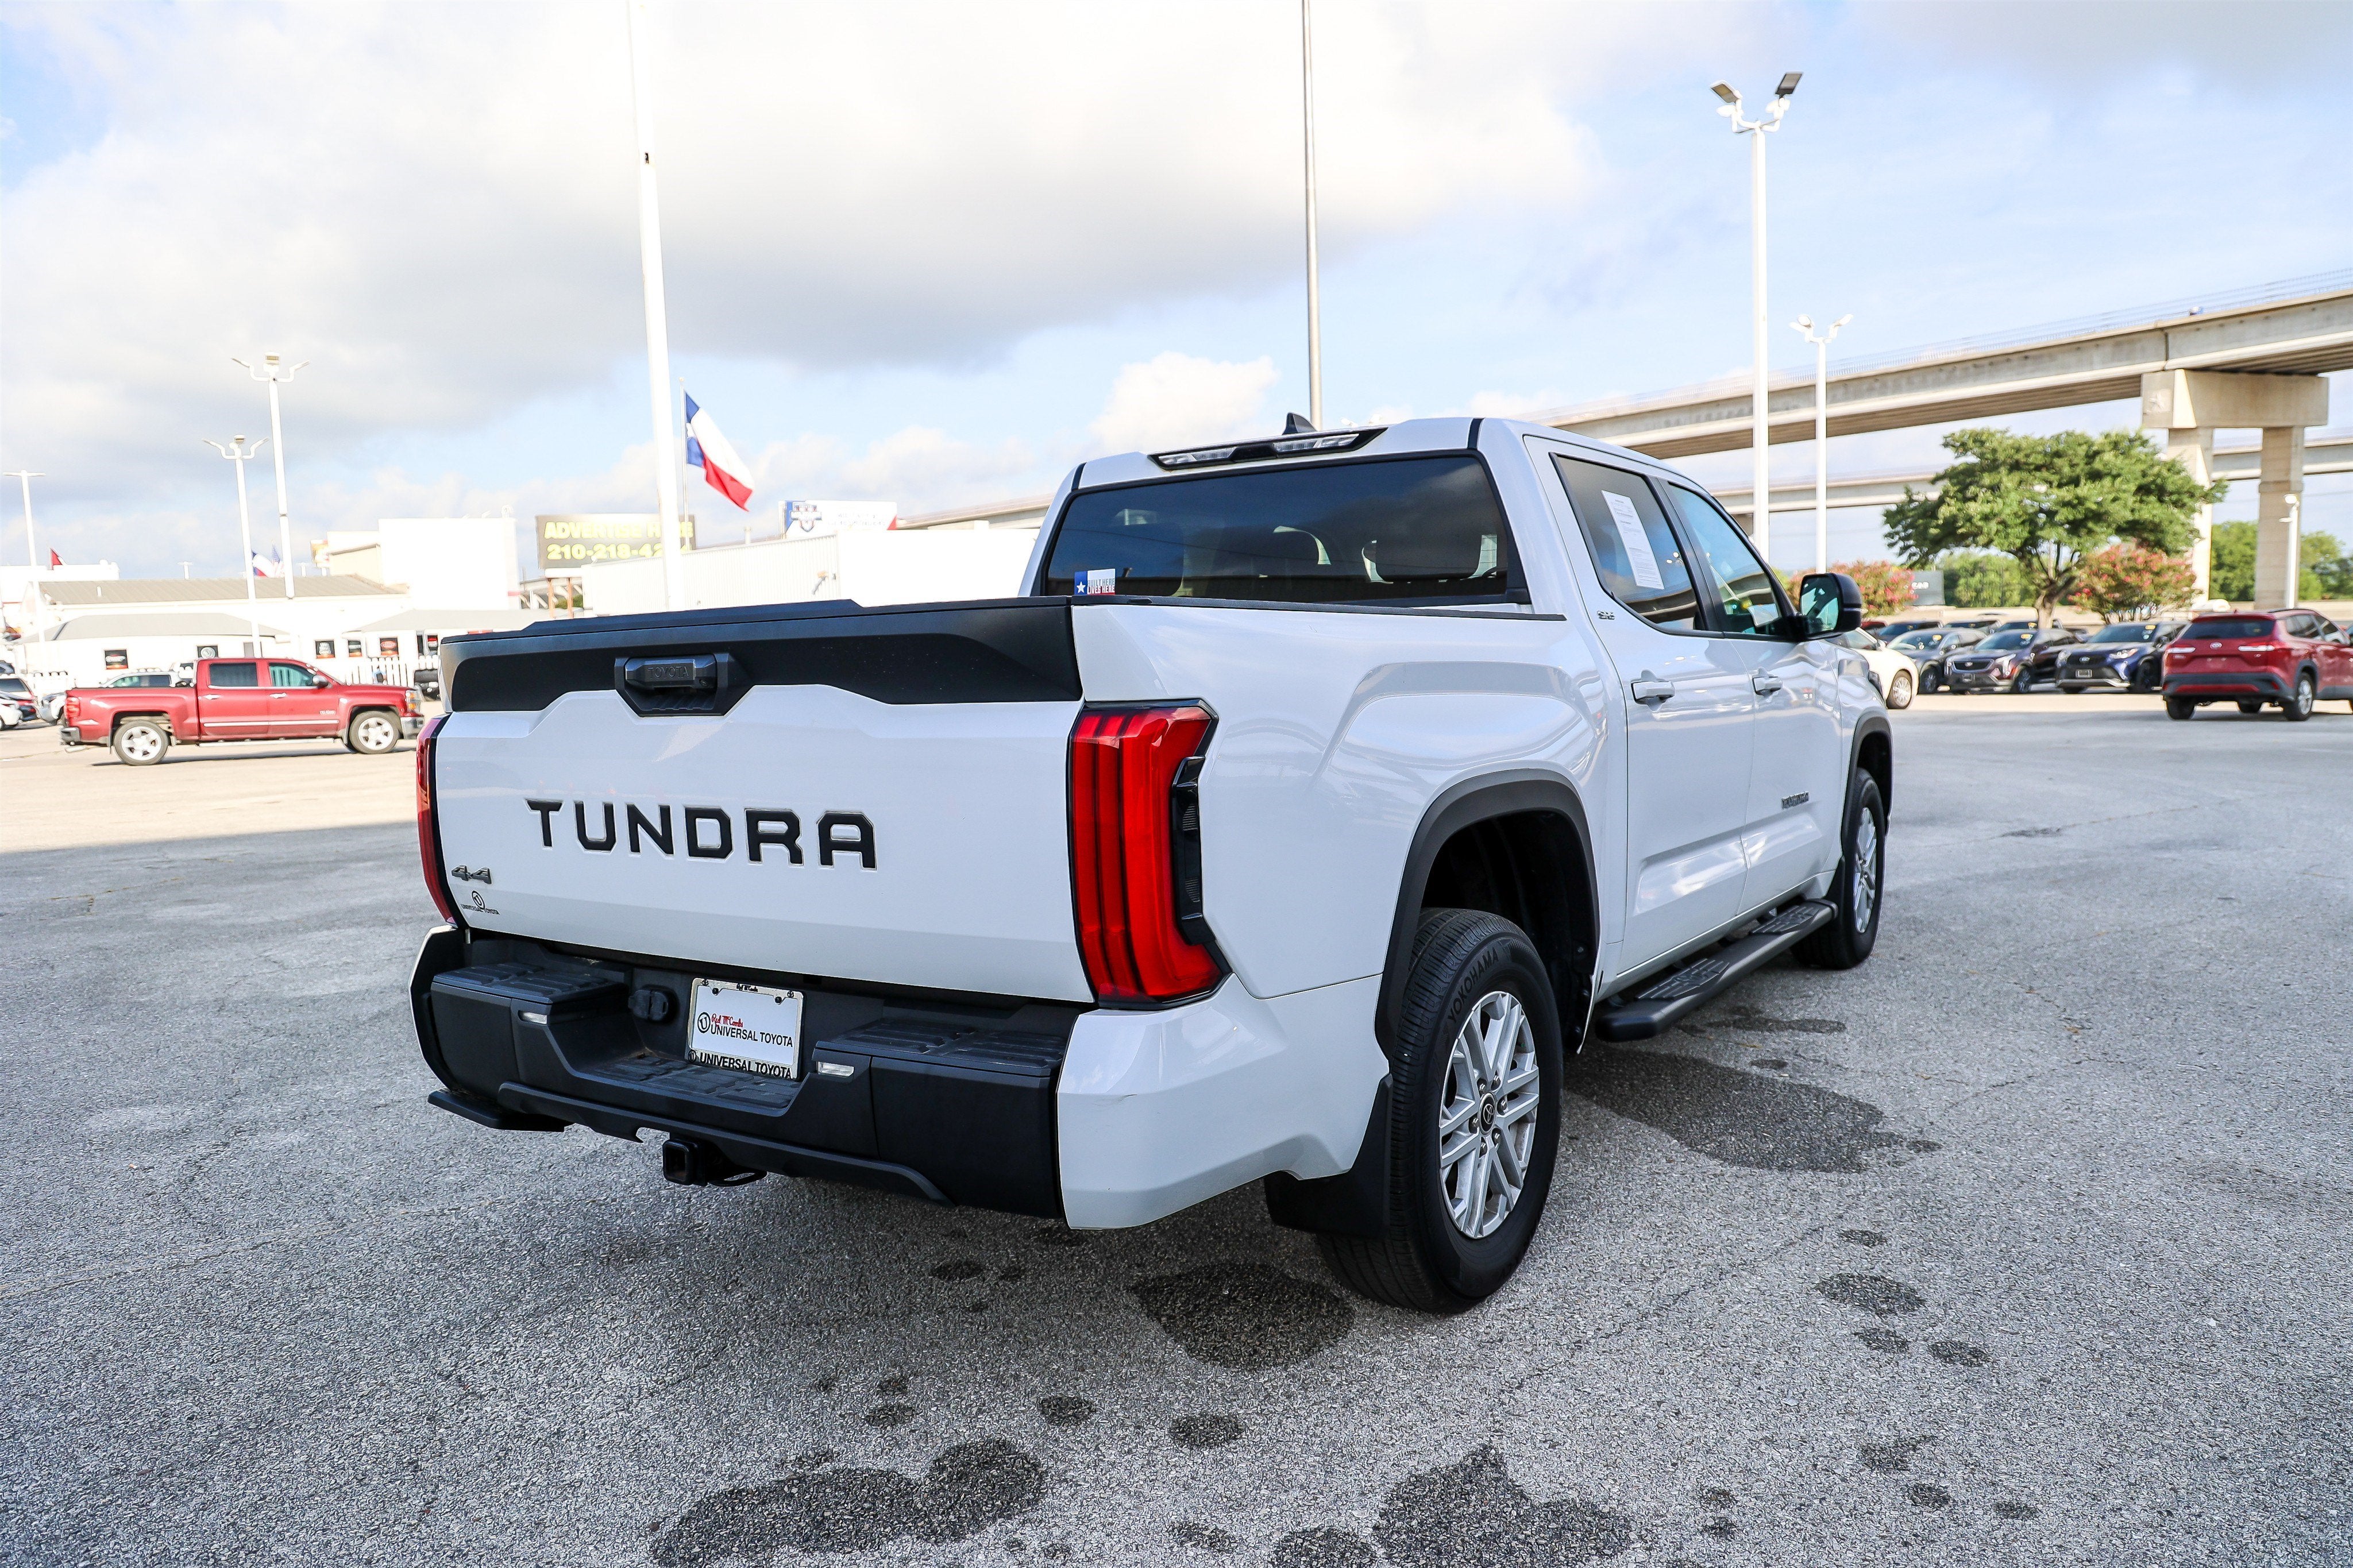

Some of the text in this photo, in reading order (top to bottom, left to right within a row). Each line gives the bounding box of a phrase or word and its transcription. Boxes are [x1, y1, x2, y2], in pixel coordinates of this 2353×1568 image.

[544, 522, 642, 539] ADVERTISE
[647, 666, 689, 678] TOYOTA
[525, 800, 877, 871] TUNDRA
[1448, 947, 1499, 1023] YOKOHAMA
[711, 1013, 743, 1028] Red McCombs
[711, 1024, 793, 1048] UNIVERSAL TOYOTA
[700, 1052, 792, 1079] UNIVERSAL TOYOTA
